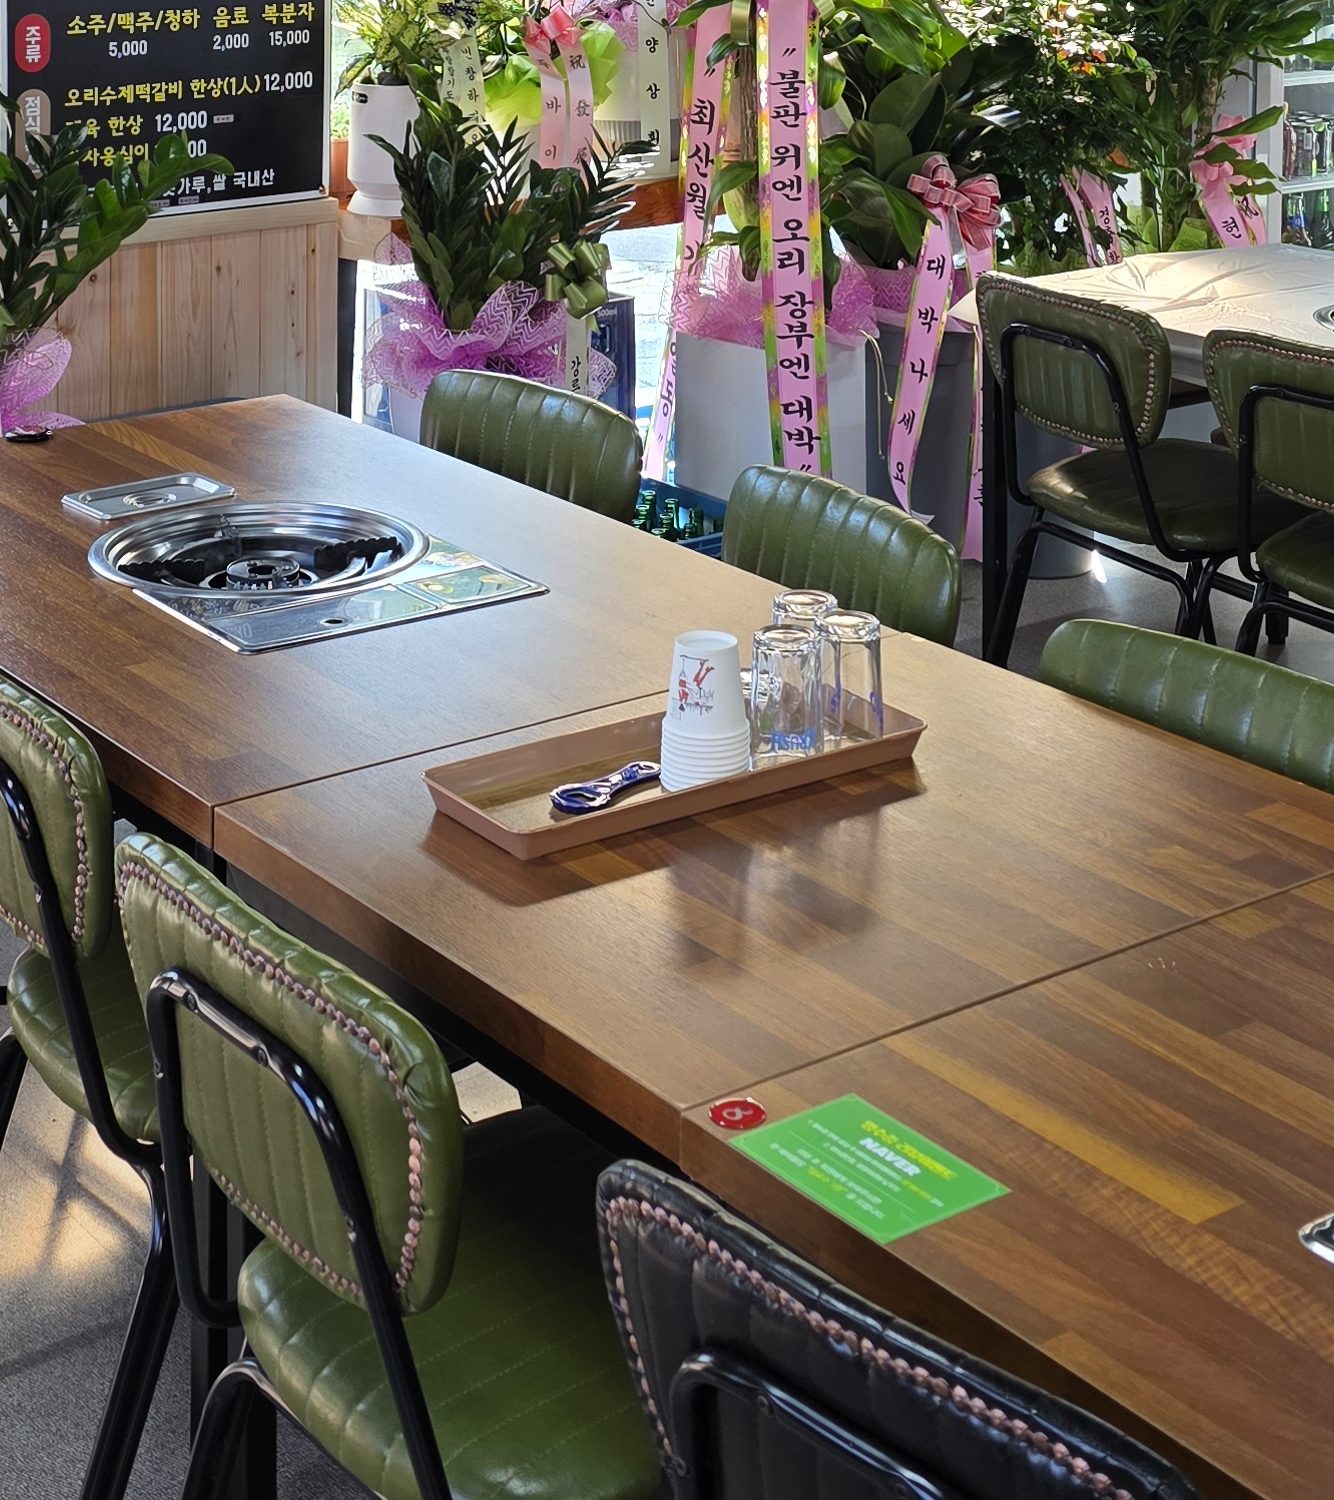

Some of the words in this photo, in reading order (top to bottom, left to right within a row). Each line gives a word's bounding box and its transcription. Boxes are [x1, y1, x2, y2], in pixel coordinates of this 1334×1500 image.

[67, 8, 200, 36] 소주/맥주/청하
[212, 6, 249, 29] 음료
[262, 3, 314, 25] 복분자
[25, 26, 42, 63] 주류
[108, 39, 148, 58] 5,000
[212, 33, 249, 52] 2,000
[268, 29, 310, 47] 15,000
[64, 79, 182, 108] 오리수제떡갈비
[264, 70, 313, 93] 12,000
[66, 118, 100, 138] 육
[108, 114, 143, 136] 한상
[154, 110, 207, 133] 12,000
[68, 143, 149, 167] 자옹심이
[770, 144, 803, 201] 위엔
[233, 168, 275, 189] 국내산
[772, 217, 810, 275] 오리
[775, 291, 815, 380] 장부엔
[892, 253, 946, 486] 대박나세요
[859, 1137, 922, 1177] NAVER
